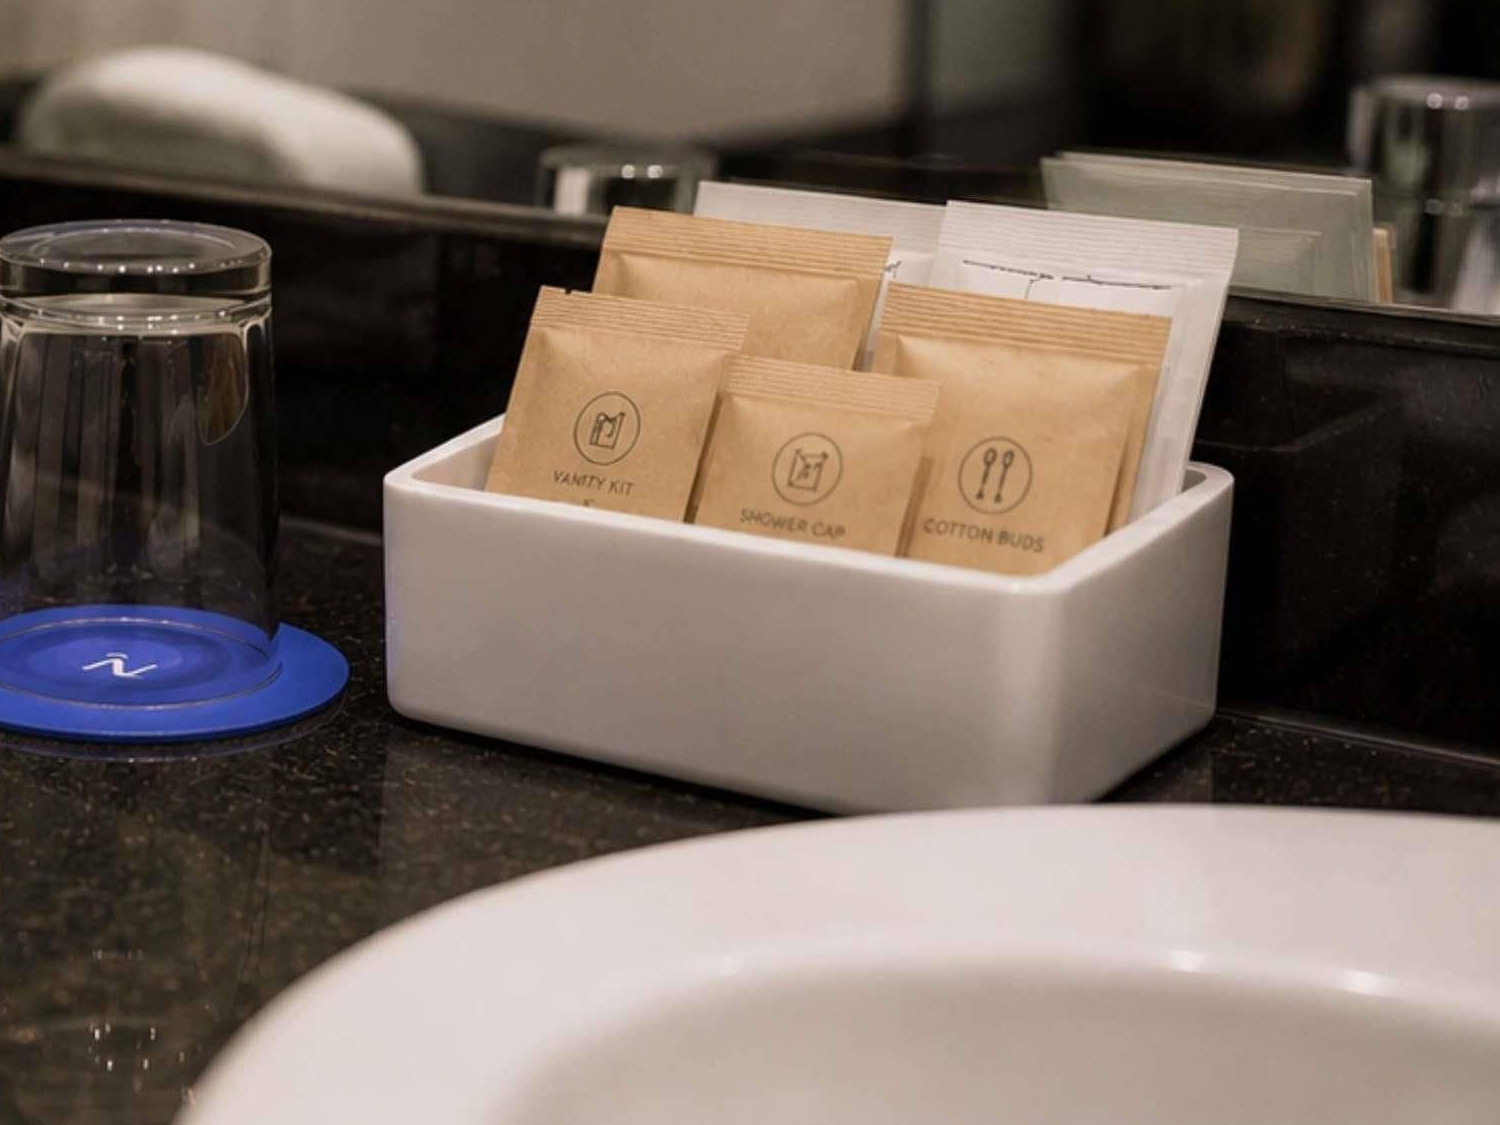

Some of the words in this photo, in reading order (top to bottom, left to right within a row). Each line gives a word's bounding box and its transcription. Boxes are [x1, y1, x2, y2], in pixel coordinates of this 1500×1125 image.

[553, 469, 607, 491] VANITY
[607, 479, 635, 497] KIT
[739, 507, 808, 533] SHOWER
[923, 517, 994, 544] COTTON
[997, 529, 1044, 554] BUDS
